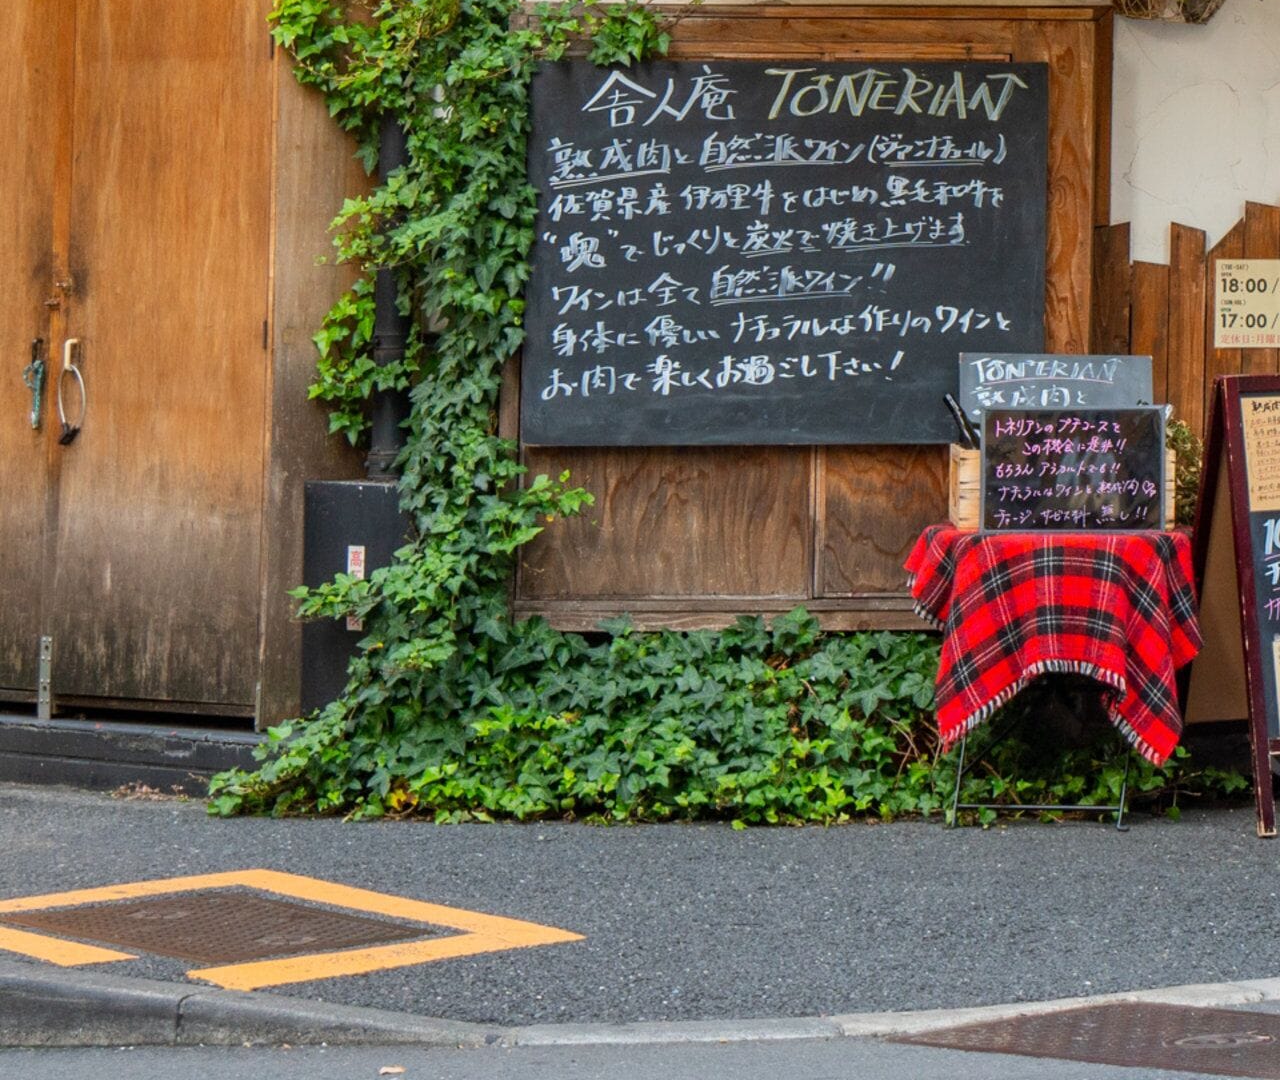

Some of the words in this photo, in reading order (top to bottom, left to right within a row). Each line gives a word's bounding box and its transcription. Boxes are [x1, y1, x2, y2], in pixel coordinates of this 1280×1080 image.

[765, 68, 1028, 121] TONERIAN
[1221, 278, 1268, 293] 18:00
[1221, 314, 1267, 329] 17:00
